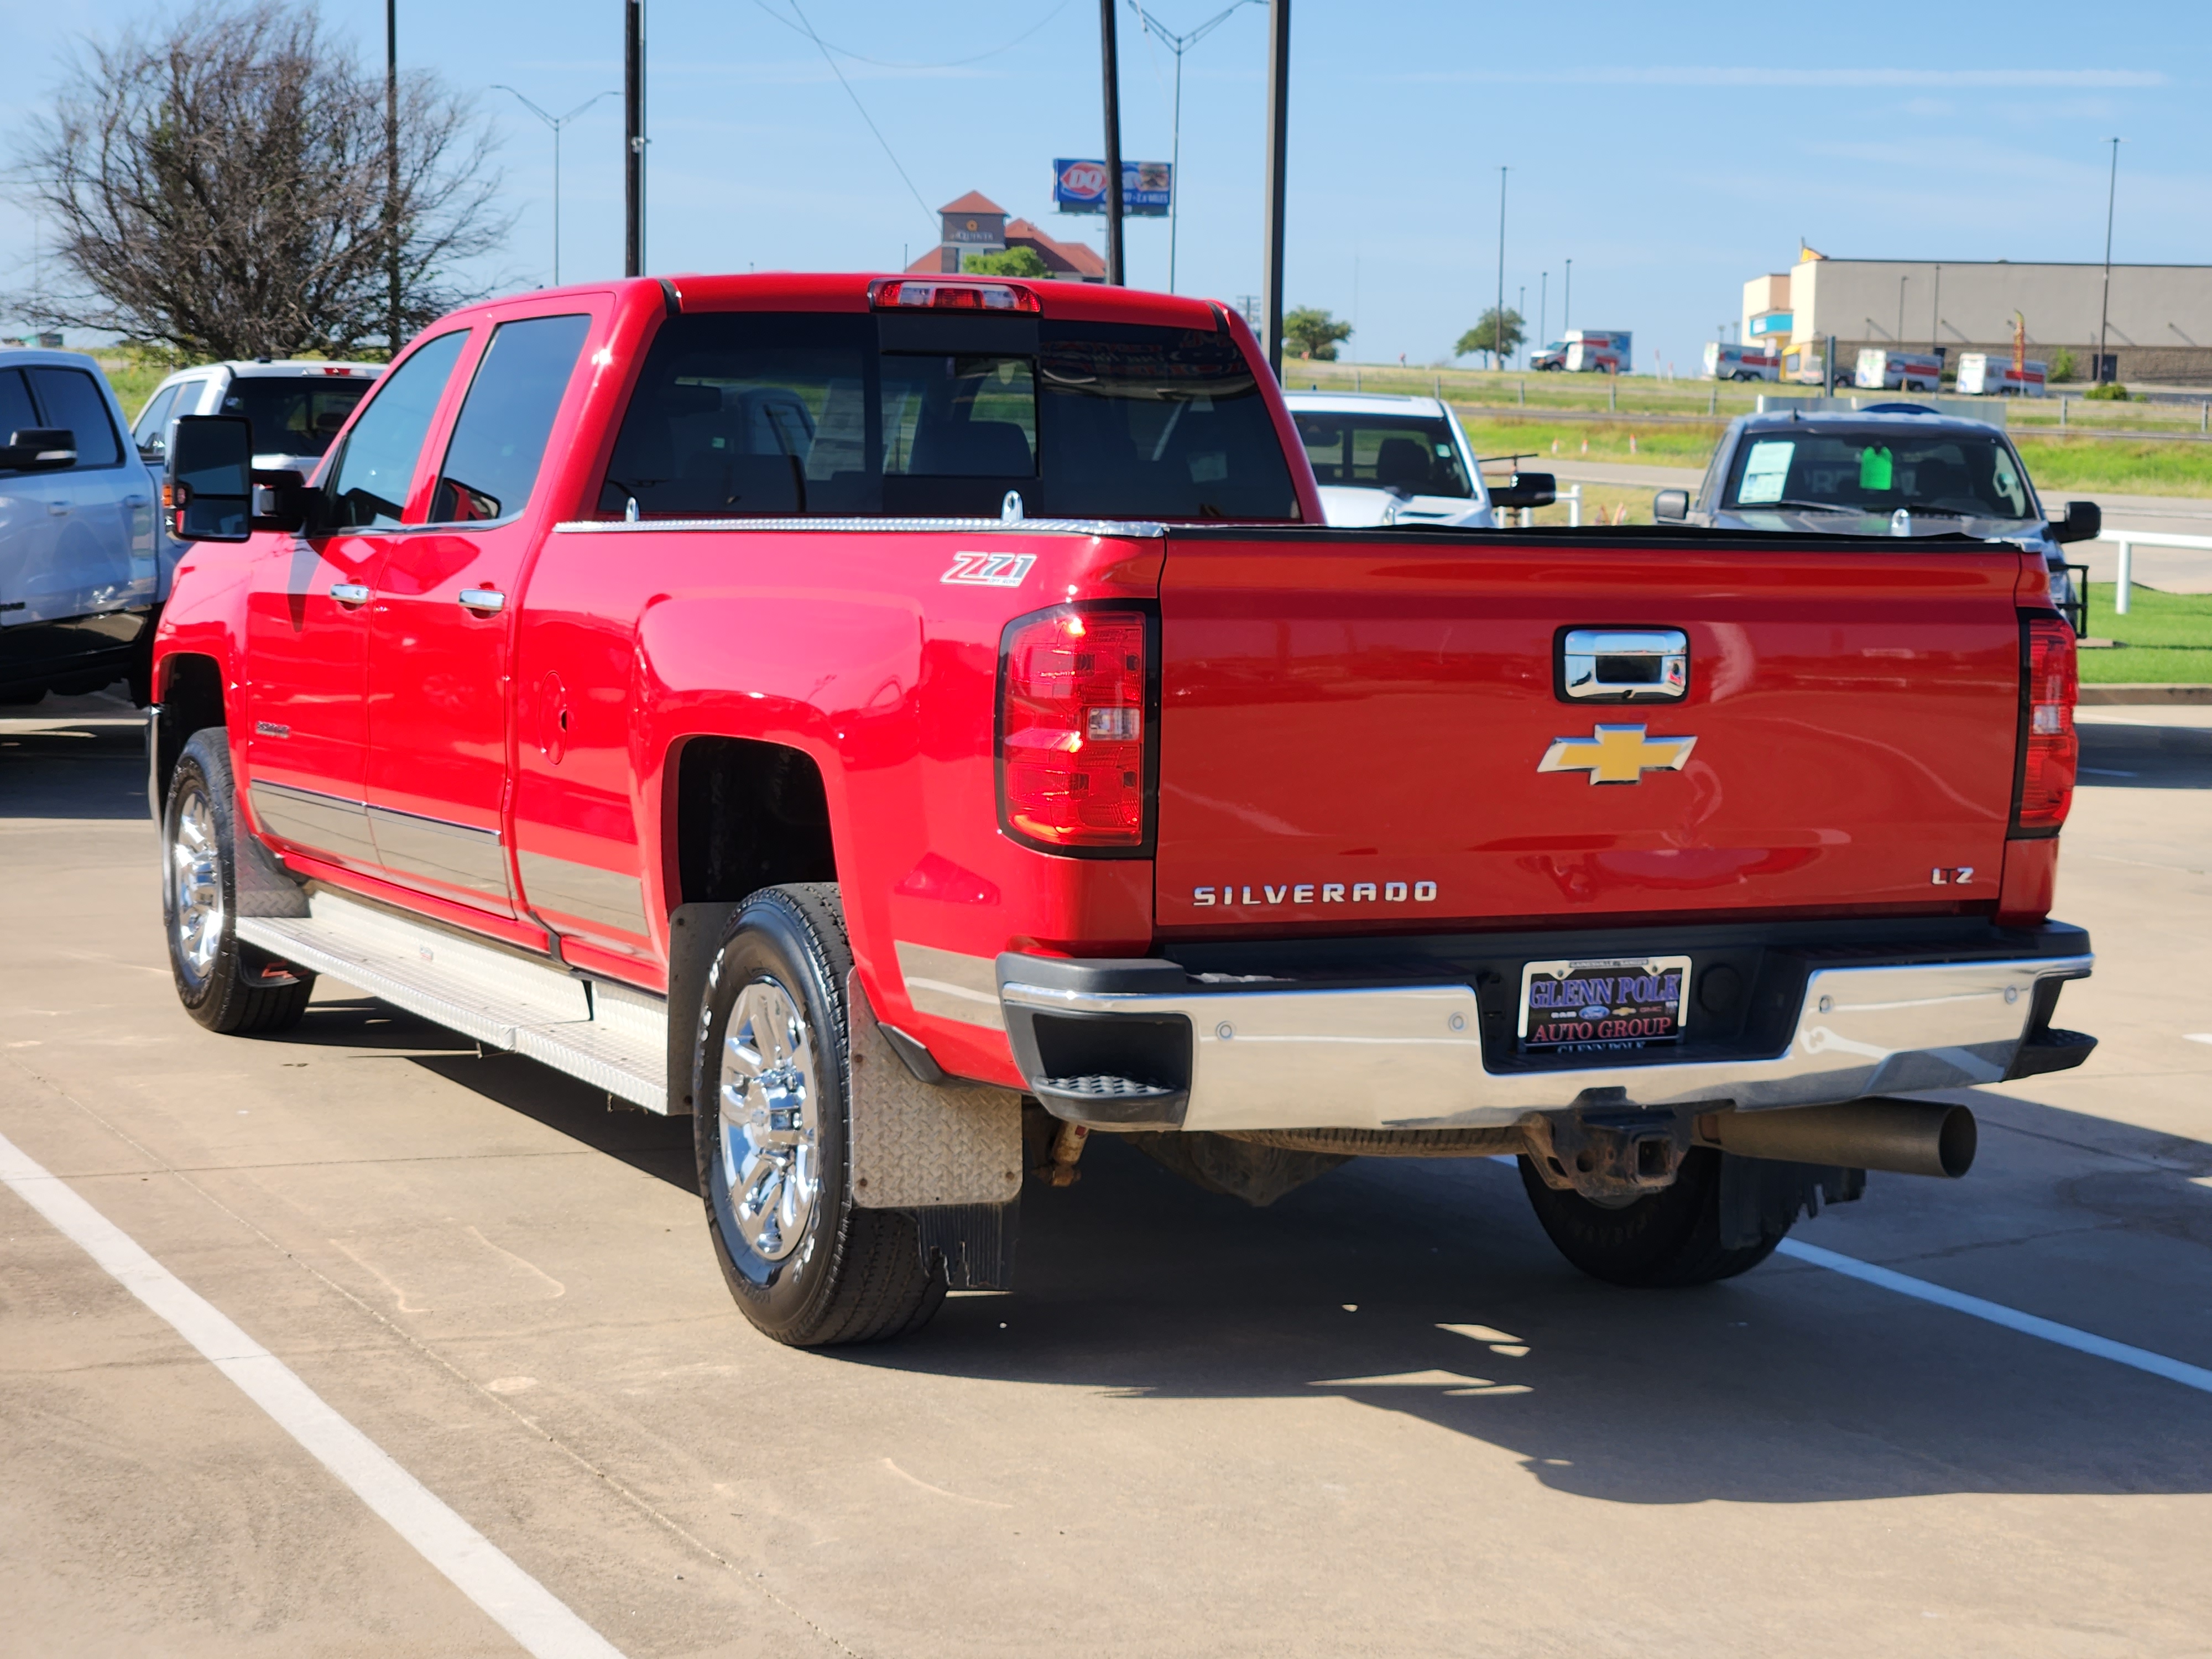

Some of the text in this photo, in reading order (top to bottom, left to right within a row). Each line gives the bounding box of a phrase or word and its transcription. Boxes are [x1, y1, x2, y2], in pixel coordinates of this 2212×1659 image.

[1069, 169, 1102, 192] DQ
[940, 551, 1038, 588] Z71
[1932, 867, 1974, 885] LTZ
[1192, 880, 1437, 905] SILVERADO
[1530, 973, 1682, 1009] GLENN POLK
[1531, 1016, 1671, 1042] AUTO GROUP
